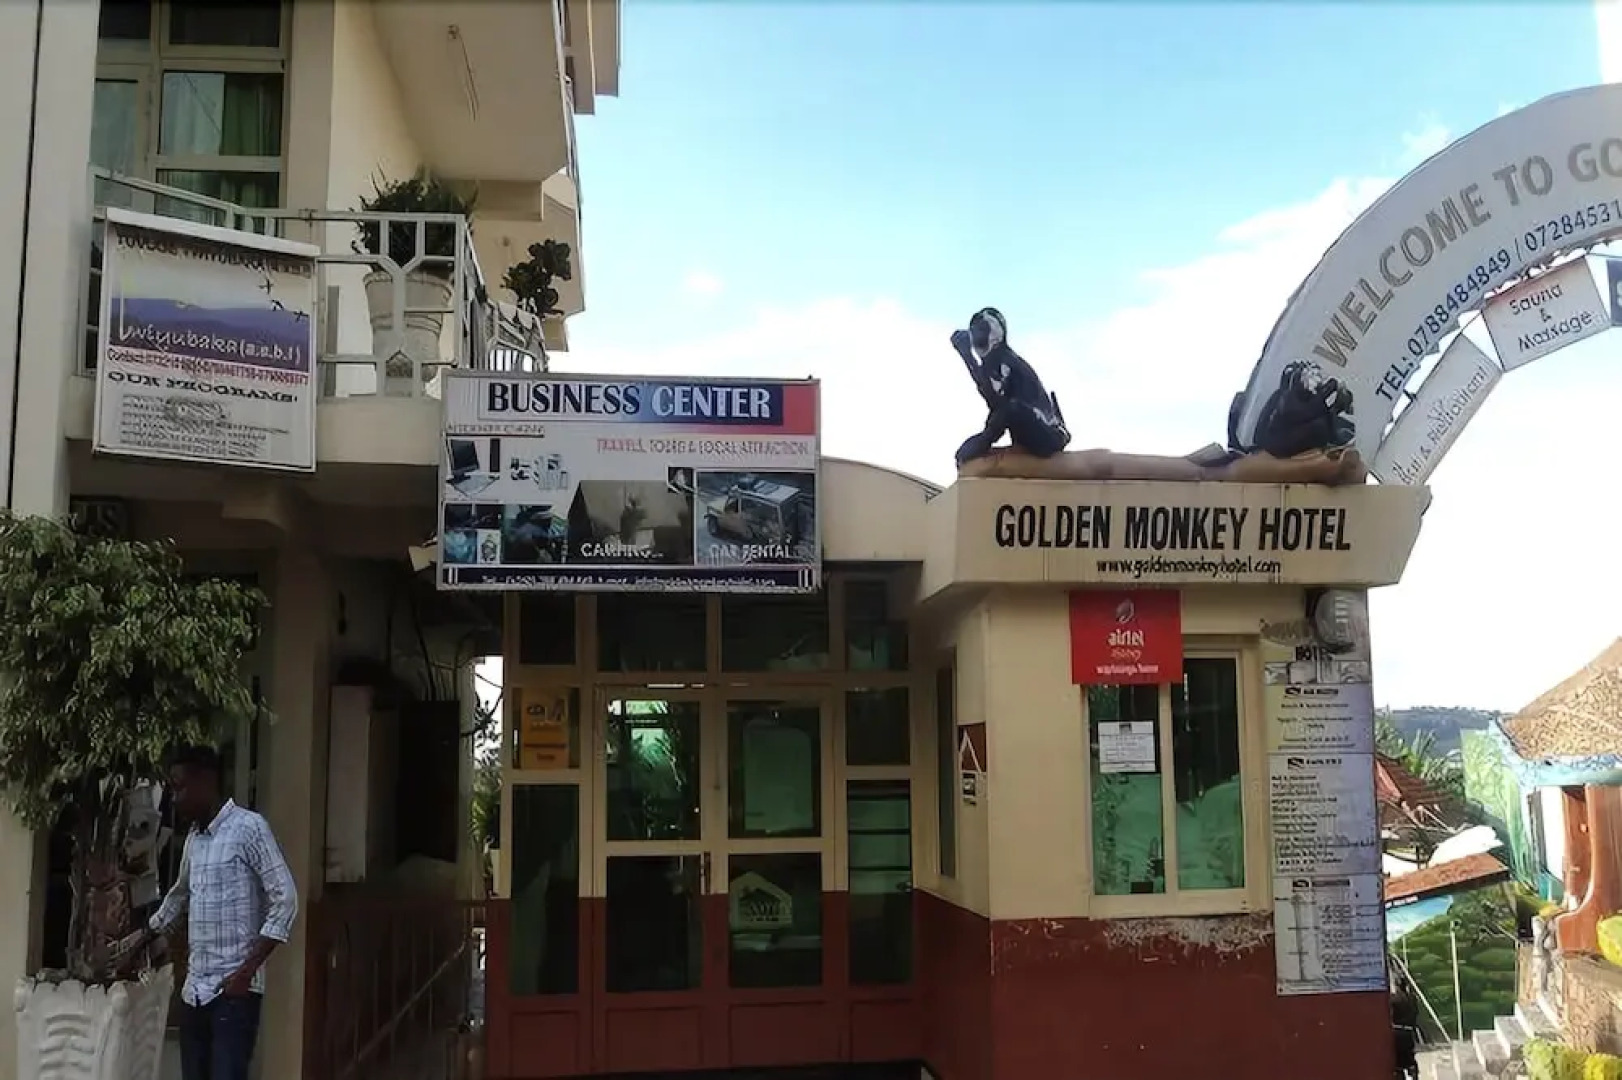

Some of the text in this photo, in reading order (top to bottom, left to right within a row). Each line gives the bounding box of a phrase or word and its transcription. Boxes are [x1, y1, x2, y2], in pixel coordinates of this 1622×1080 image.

[1313, 183, 1491, 368] WELCOME
[1492, 155, 1553, 206] TO
[1509, 284, 1563, 316] Sauna
[488, 382, 771, 418] BUSINESS CENTER
[995, 504, 1351, 551] GOLDEN MONKEY HOTEL
